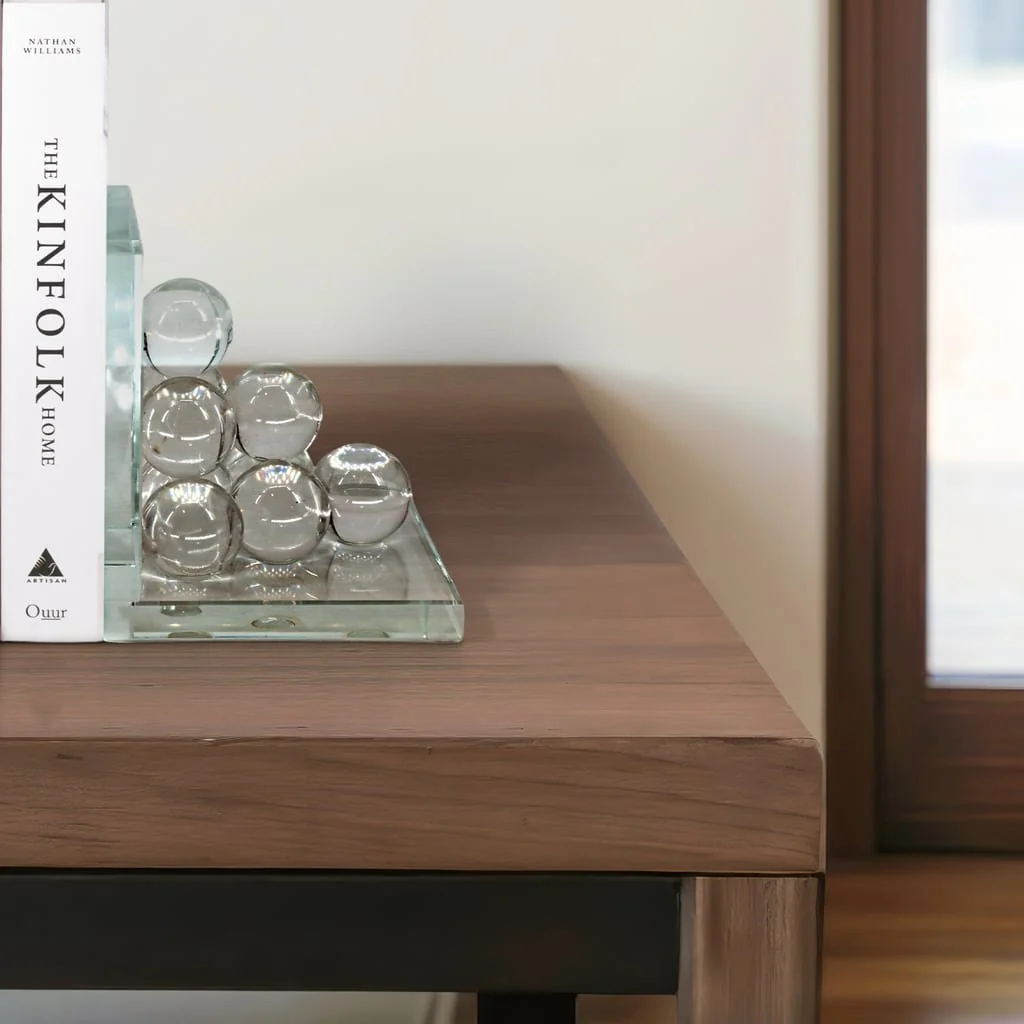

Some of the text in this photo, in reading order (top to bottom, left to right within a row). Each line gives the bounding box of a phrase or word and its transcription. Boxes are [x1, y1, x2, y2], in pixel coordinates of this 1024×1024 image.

[28, 38, 77, 46] NATHAN
[23, 47, 82, 55] WILLIAMS
[35, 137, 67, 467] THE KINFOLK HOME
[25, 603, 68, 621] Ouur
